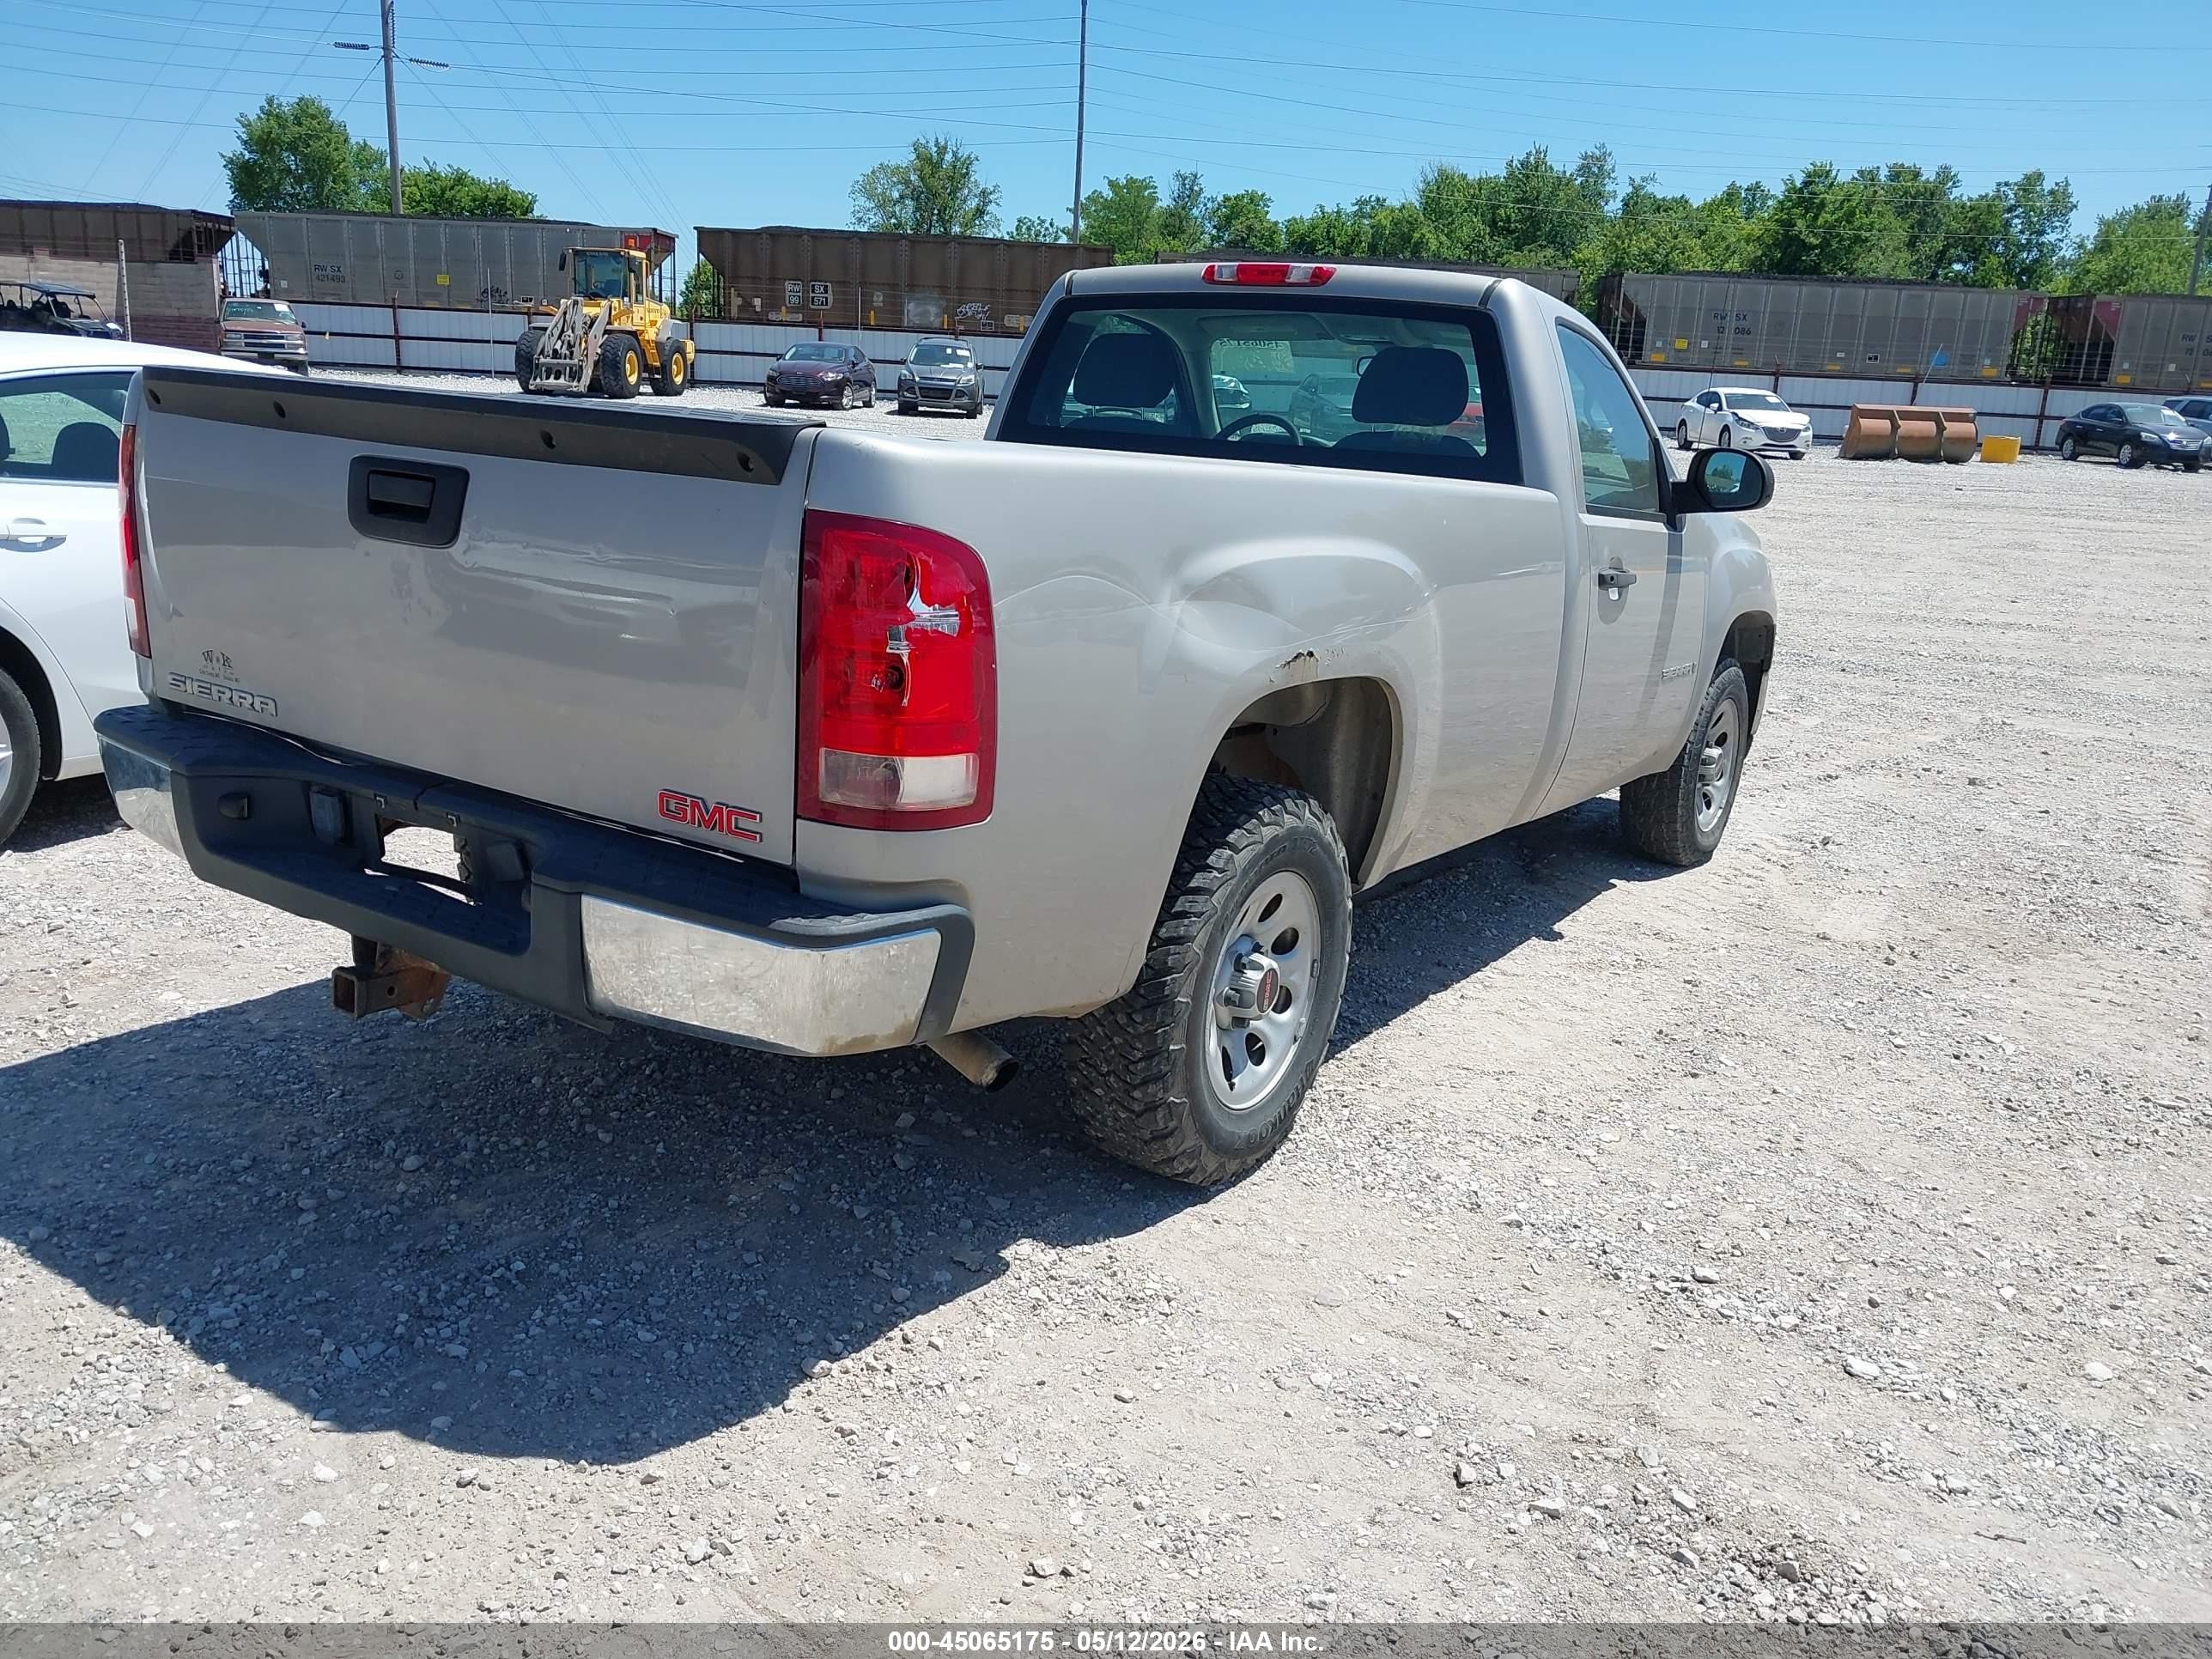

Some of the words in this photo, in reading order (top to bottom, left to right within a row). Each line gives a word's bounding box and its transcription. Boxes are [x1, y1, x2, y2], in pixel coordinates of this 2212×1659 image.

[314, 264, 327, 272] RW
[787, 283, 800, 292] RW
[814, 284, 825, 294] SX
[789, 295, 799, 304] 99
[813, 297, 826, 306] 571
[1713, 313, 1728, 321] RW
[1735, 313, 1747, 322] SX
[168, 672, 277, 717] SIERRA
[658, 789, 763, 843] GMC
[1262, 970, 1273, 1011] GMC
